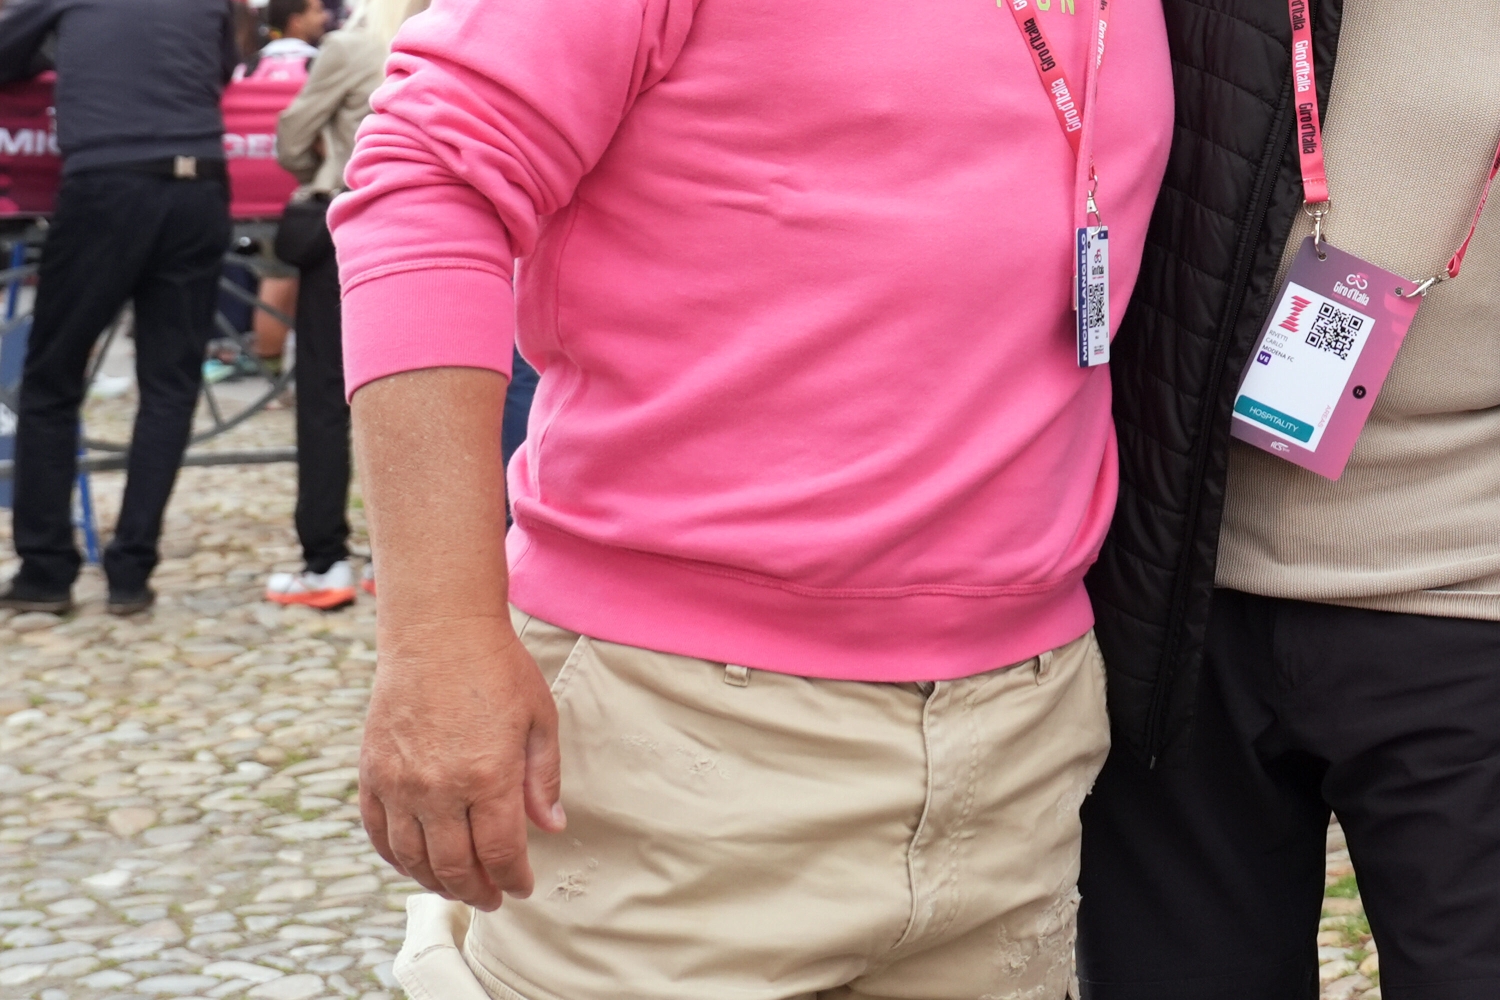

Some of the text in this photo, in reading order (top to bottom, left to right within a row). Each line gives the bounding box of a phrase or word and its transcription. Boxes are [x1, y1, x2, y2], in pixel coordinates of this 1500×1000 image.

[1290, 1, 1305, 31] d'Italia
[1023, 17, 1056, 73] Giro d'Italia
[1294, 39, 1312, 93] Giro d'Italia
[1051, 77, 1082, 133] Giro d'Italia
[1299, 102, 1317, 155] Giro d'Italia
[1333, 281, 1349, 297] Giro
[1347, 288, 1370, 306] d'Italia
[1265, 337, 1284, 349] CARLO
[1269, 330, 1289, 342] RIVETTI
[1262, 344, 1287, 359] MODENA
[1248, 406, 1299, 433] HOSPITALITY
